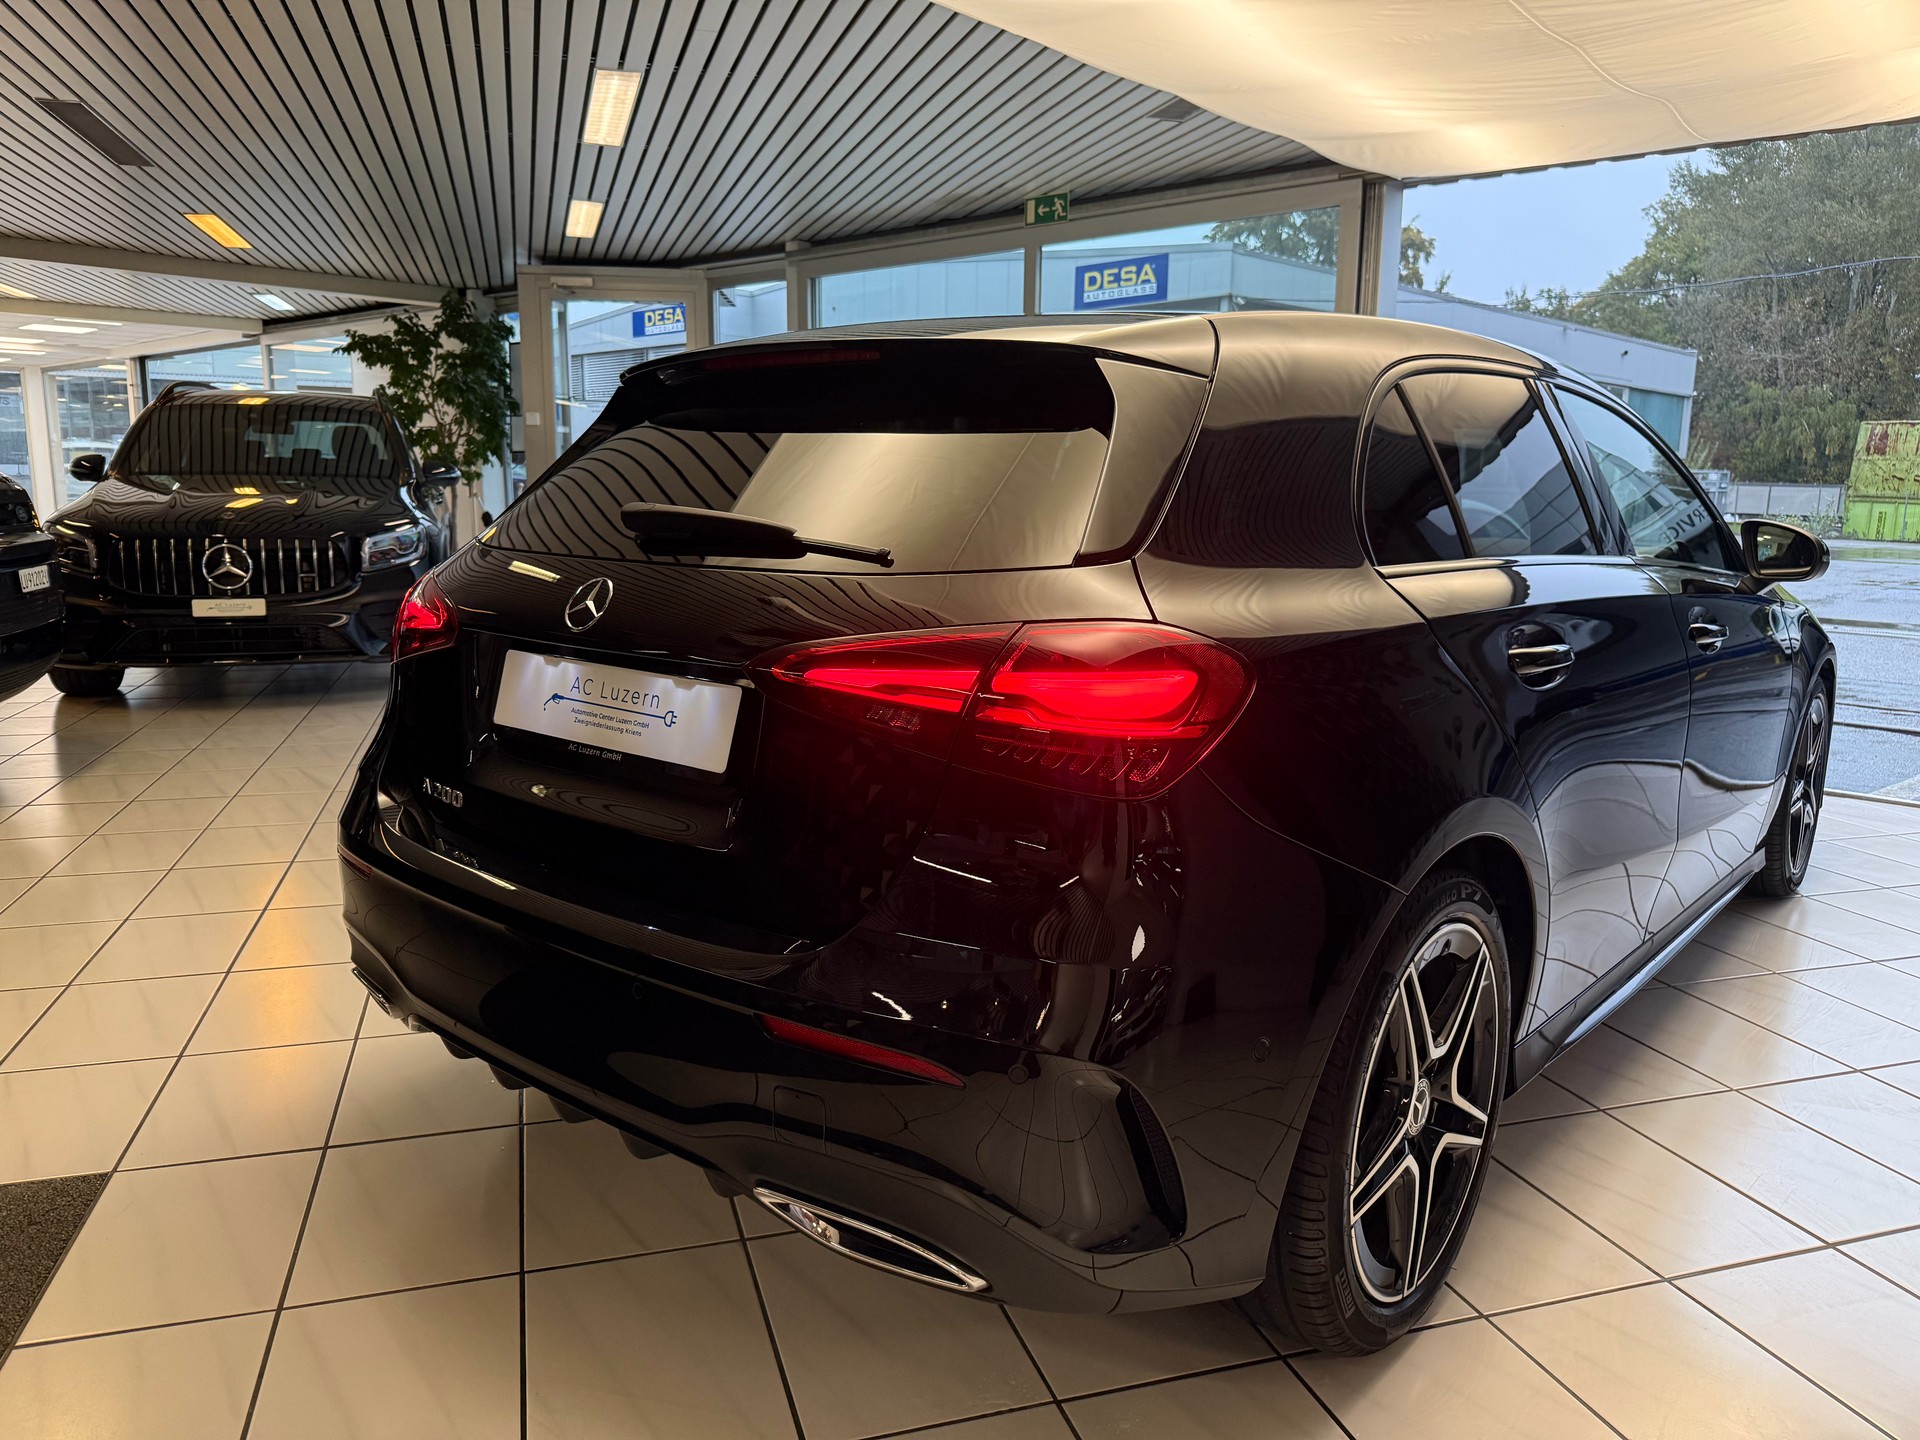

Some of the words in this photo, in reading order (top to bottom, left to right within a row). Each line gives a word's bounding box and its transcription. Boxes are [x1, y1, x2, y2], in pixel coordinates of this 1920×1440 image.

[1084, 263, 1156, 292] DESA
[1085, 285, 1155, 301] AUTOGLASS
[645, 307, 685, 327] DESA
[570, 676, 594, 695] AC
[600, 681, 661, 709] Luzern
[571, 707, 598, 719] Automotive
[599, 713, 615, 721] Center
[616, 716, 633, 725] Luzern
[633, 720, 649, 729] GmbH
[573, 717, 625, 734] Zweigniederlassung
[625, 727, 642, 737] Kriens
[567, 743, 577, 751] AC
[578, 745, 601, 757] Luzern
[602, 750, 622, 762] GmbH
[1460, 883, 1482, 902] P7
